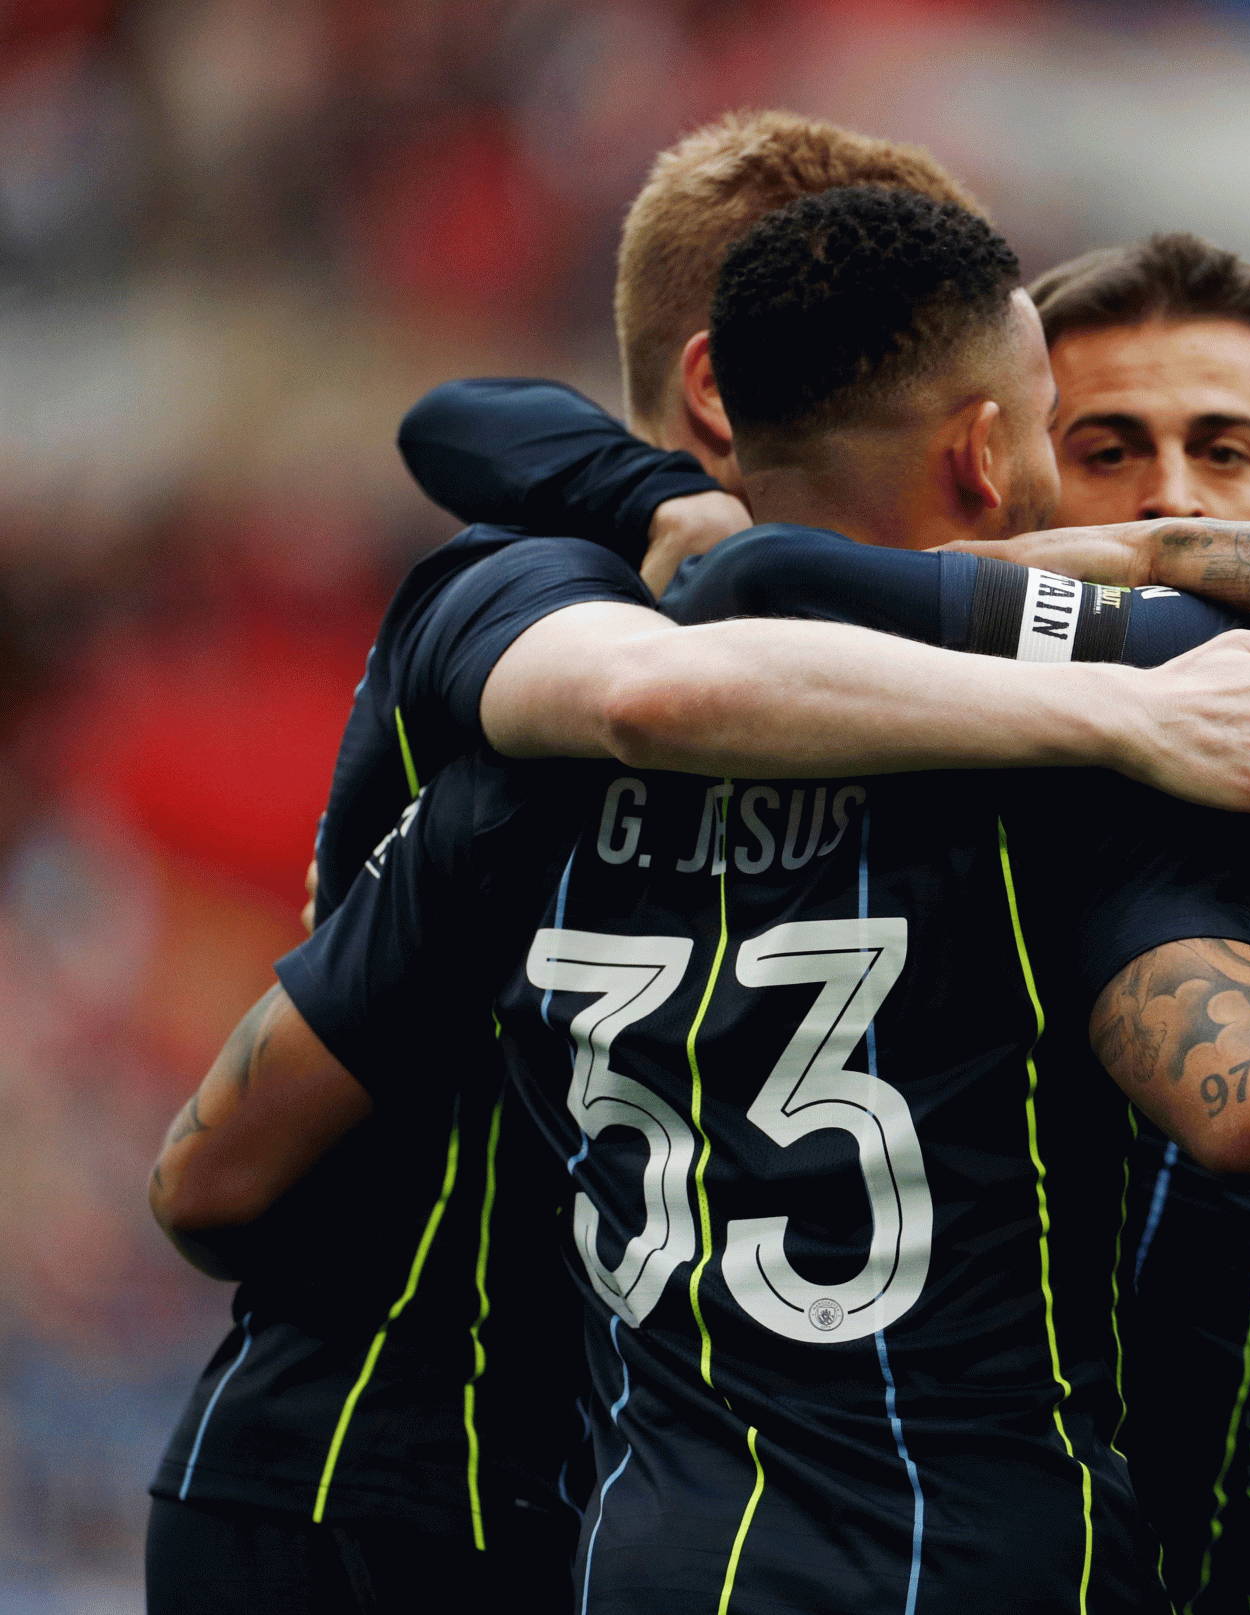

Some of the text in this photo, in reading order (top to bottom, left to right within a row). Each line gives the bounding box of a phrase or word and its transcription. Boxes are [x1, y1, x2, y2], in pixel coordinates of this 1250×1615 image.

[597, 777, 867, 876] G. JESUS
[526, 917, 934, 1343] 33
